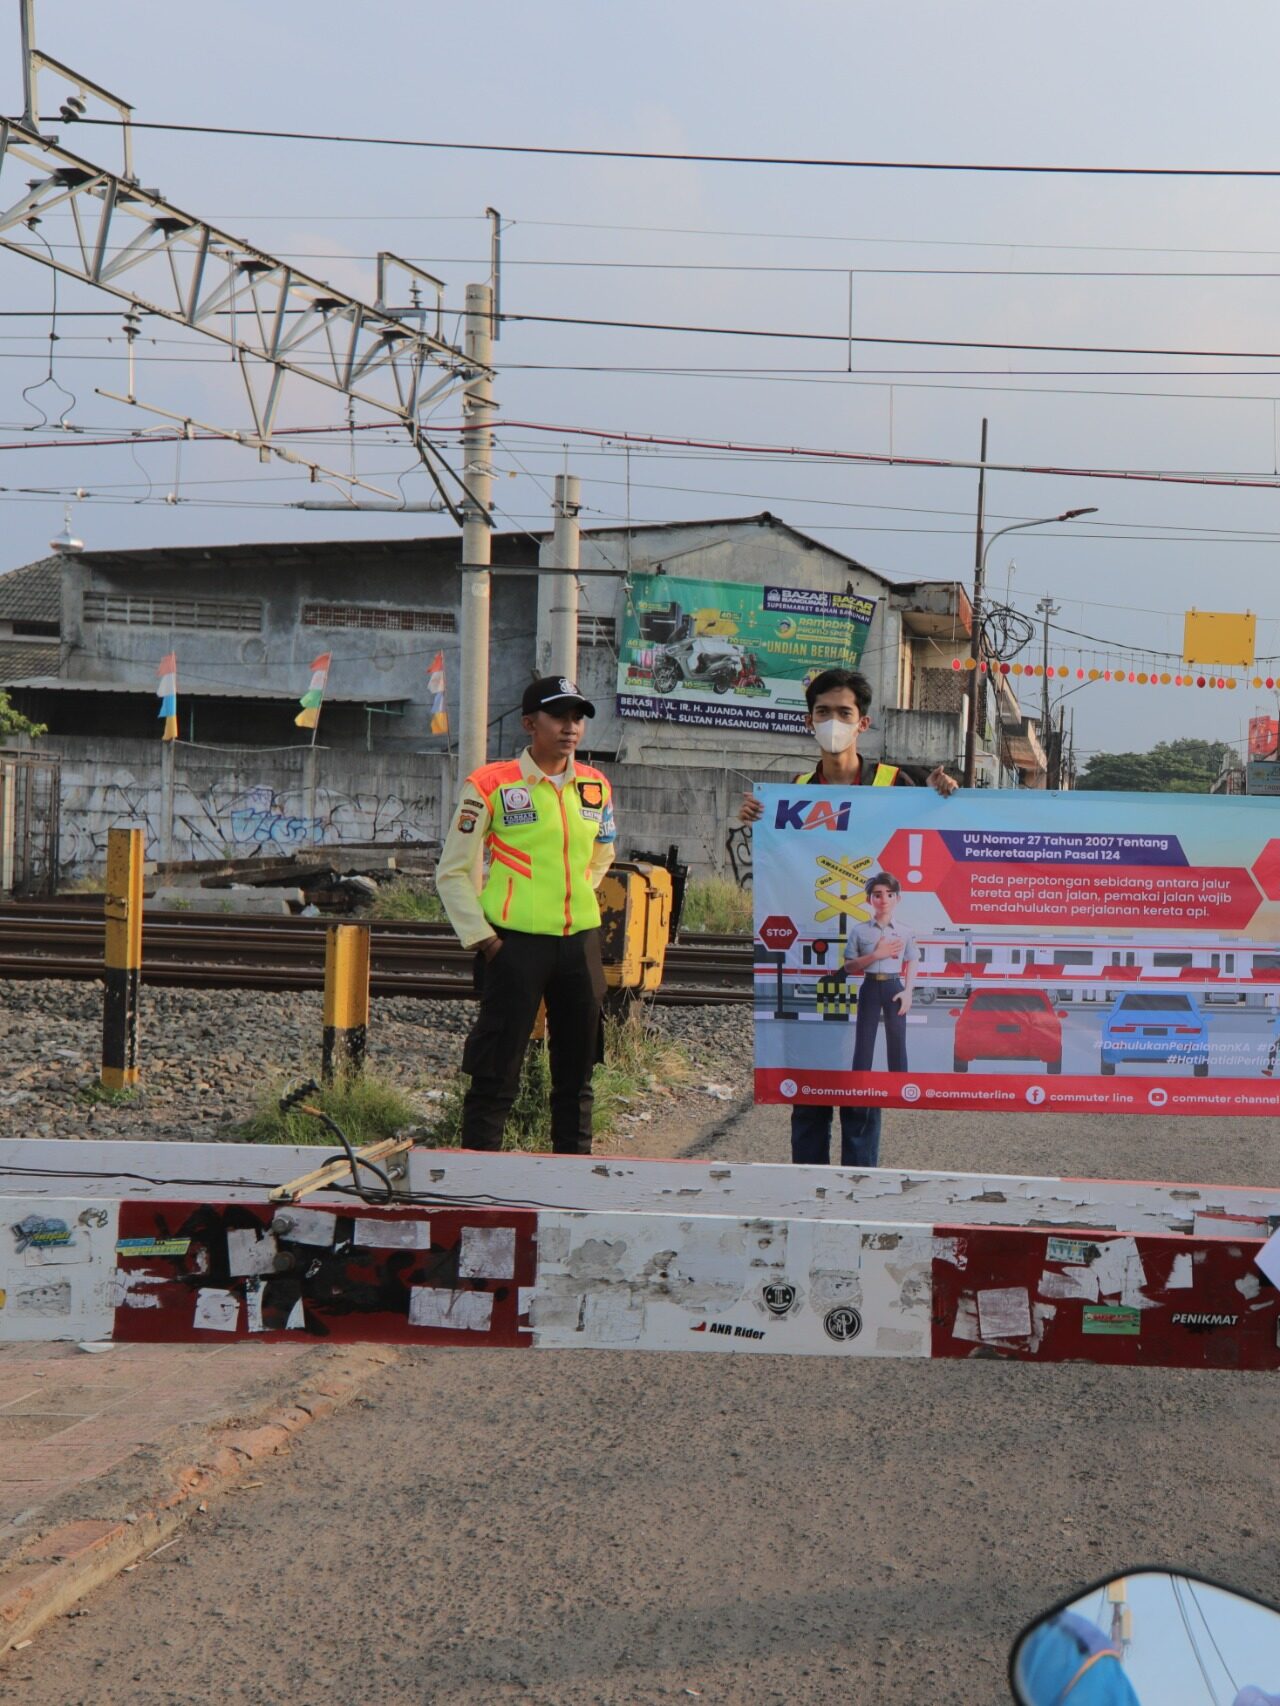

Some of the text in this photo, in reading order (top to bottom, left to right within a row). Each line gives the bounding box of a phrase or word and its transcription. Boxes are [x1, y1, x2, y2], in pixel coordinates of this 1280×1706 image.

[767, 601, 813, 612] SUPERMARKET
[781, 589, 873, 609] BAZAR BAZAR
[767, 640, 807, 656] UNDIAN
[620, 697, 653, 707] BEKASI
[705, 706, 743, 717] JUANDA
[746, 710, 762, 719] NO.
[777, 713, 806, 722] BEKAS
[620, 708, 658, 719] TAMBUN
[678, 714, 712, 725] SULTAN
[714, 718, 769, 730] HASANUDIN
[771, 723, 808, 734] TAMBUN
[774, 800, 851, 831] KAI
[963, 834, 1169, 850] UU Nomor 27 Tahun 2007 Tentang
[965, 847, 1120, 861] Perkeretaapian Pasal 124
[971, 873, 1230, 891] Pada perpotongan sebidang antara jalur
[970, 888, 1232, 905] kereta api dan jalan, pemakai jalan wajib
[970, 902, 1209, 919] mendahulukan perjalanan kereta api.
[766, 928, 793, 937] STOP
[1094, 1040, 1250, 1053] #DahulukanPerjalananKA
[801, 1085, 888, 1097] @commuterline
[925, 1088, 1016, 1100] @commuterline
[1050, 1093, 1134, 1103] commuter line
[1172, 1094, 1280, 1104] commuter channel
[1172, 1312, 1239, 1326] PENIKMAT
[709, 1322, 766, 1340] ANR Rider
